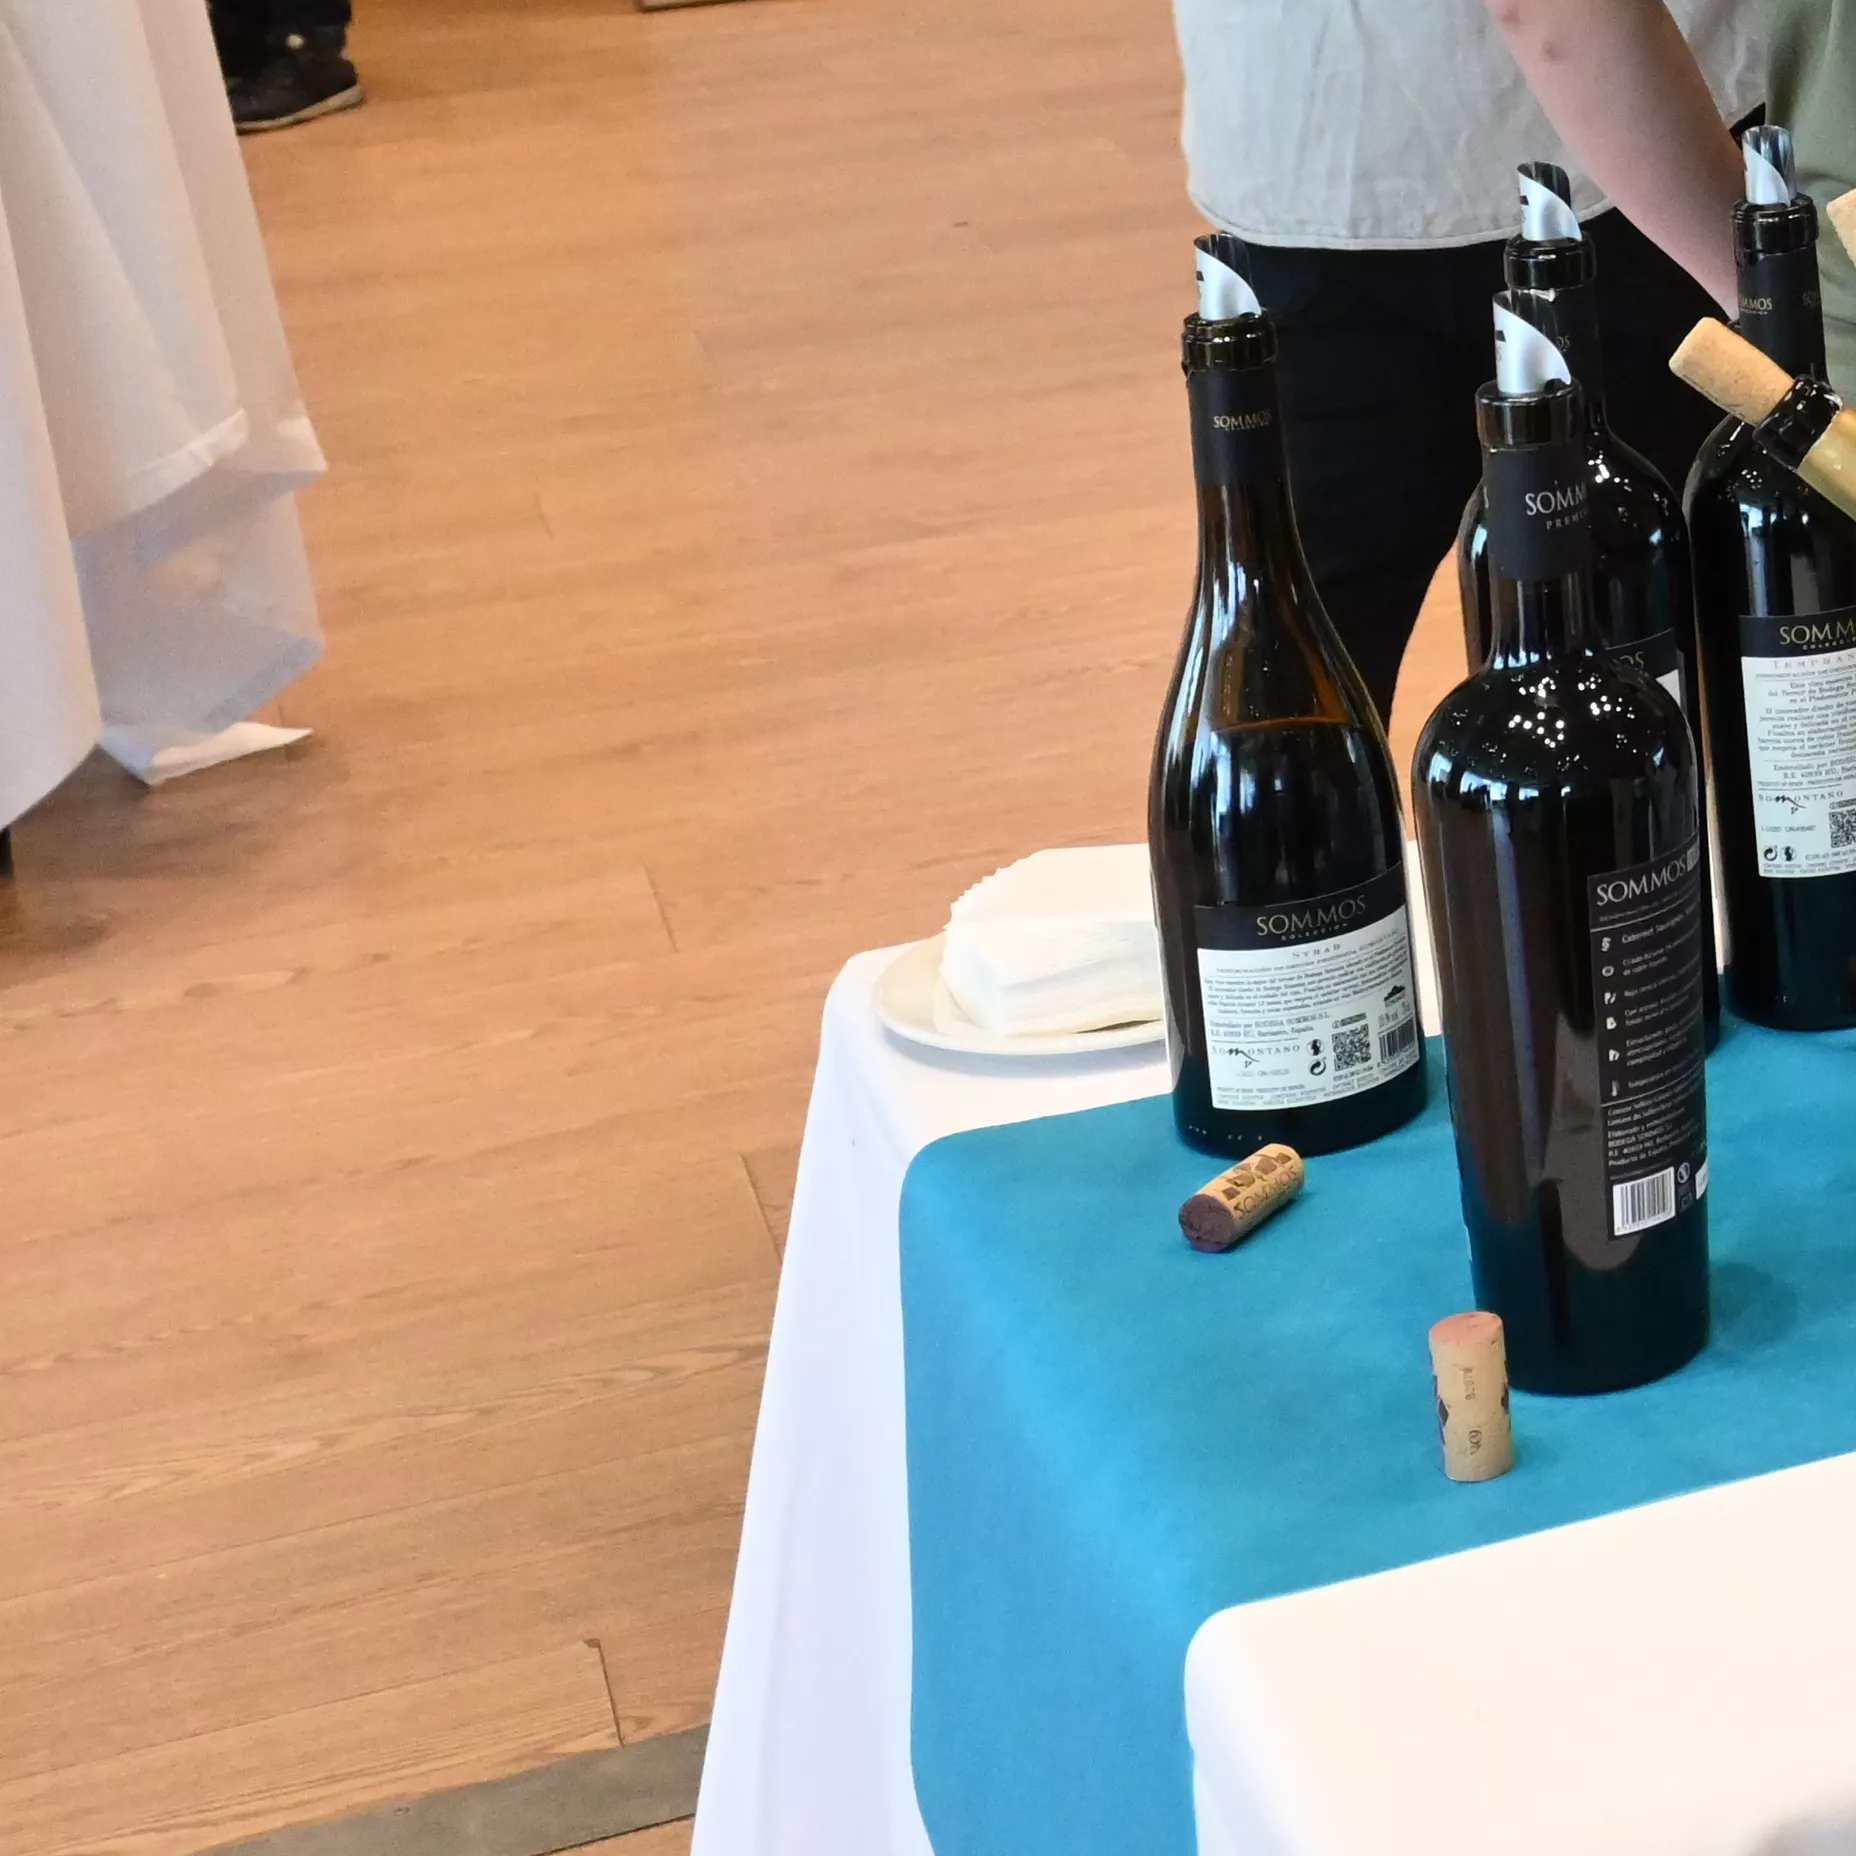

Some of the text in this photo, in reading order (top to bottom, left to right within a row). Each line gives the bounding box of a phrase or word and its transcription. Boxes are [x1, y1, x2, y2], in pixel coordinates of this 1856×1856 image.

[1525, 486, 1588, 516] SOMM
[1596, 854, 1686, 907] SOMMOS
[1256, 895, 1367, 936] SOMMOS
